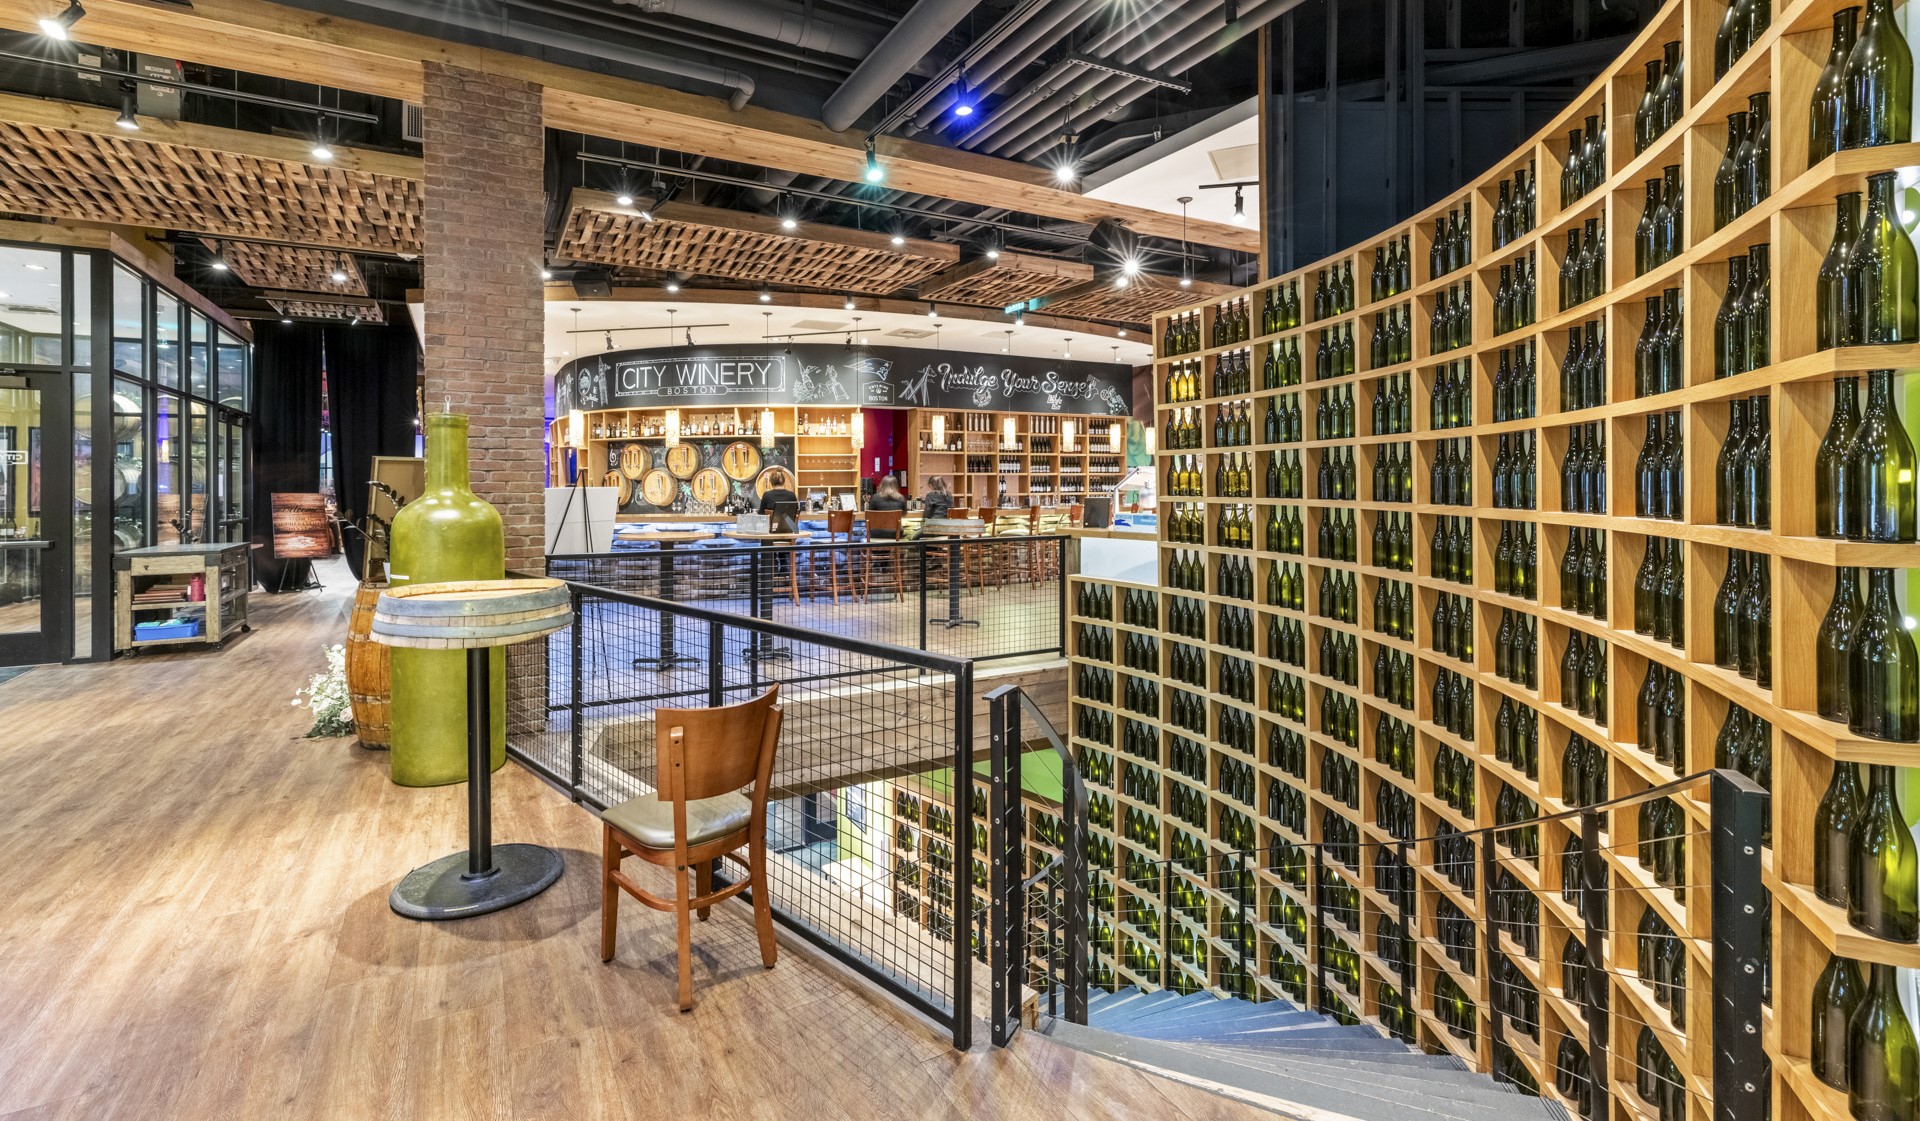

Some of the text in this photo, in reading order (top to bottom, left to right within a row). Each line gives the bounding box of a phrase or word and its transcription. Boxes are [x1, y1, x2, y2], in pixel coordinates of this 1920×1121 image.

[622, 362, 772, 389] CITY WINERY
[937, 362, 1097, 399] Indulge Your Senses
[667, 386, 717, 395] BOSTON
